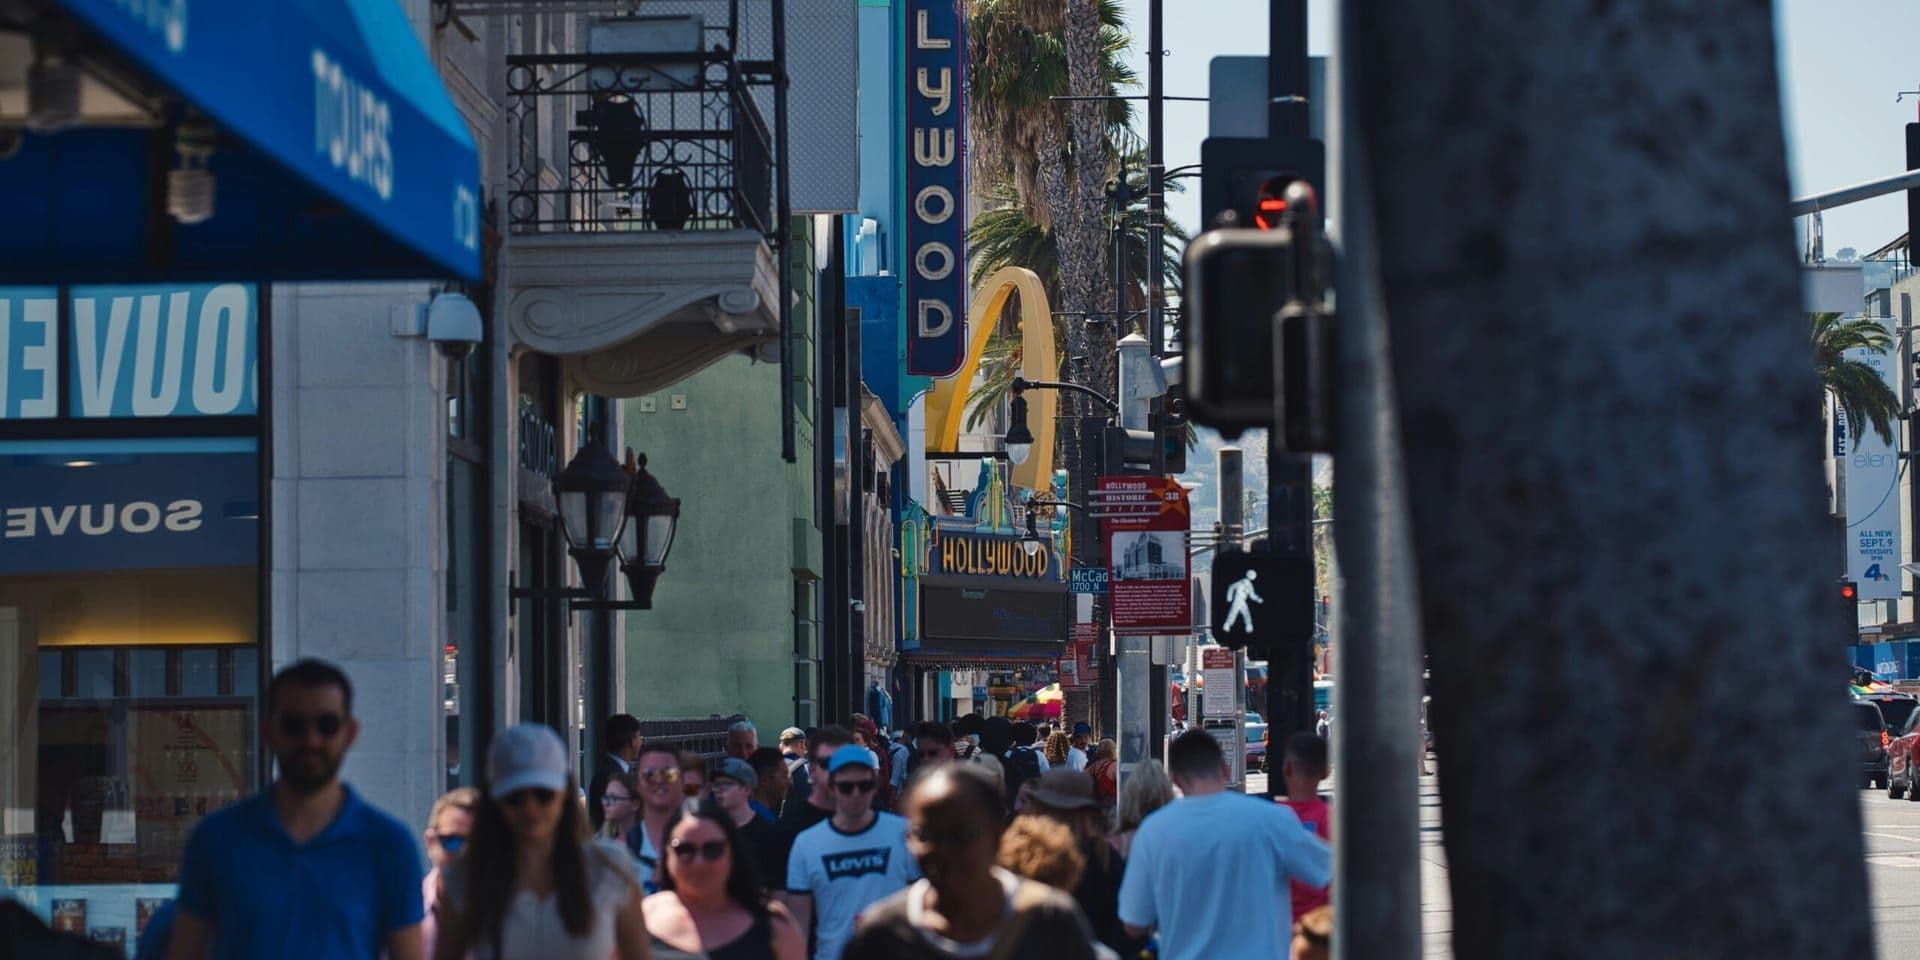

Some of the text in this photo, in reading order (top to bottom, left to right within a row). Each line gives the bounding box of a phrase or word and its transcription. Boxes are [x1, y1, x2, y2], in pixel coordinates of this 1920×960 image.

[312, 50, 393, 200] TOURS
[914, 9, 956, 339] LYWOOD
[1854, 450, 1893, 468] ellen
[1106, 482, 1147, 490] HOLLYWOOD
[1164, 491, 1180, 501] 38
[1860, 538, 1893, 548] SEPT. 9
[943, 536, 1048, 577] HOLLYWOOD
[1072, 582, 1100, 591] 1700 N
